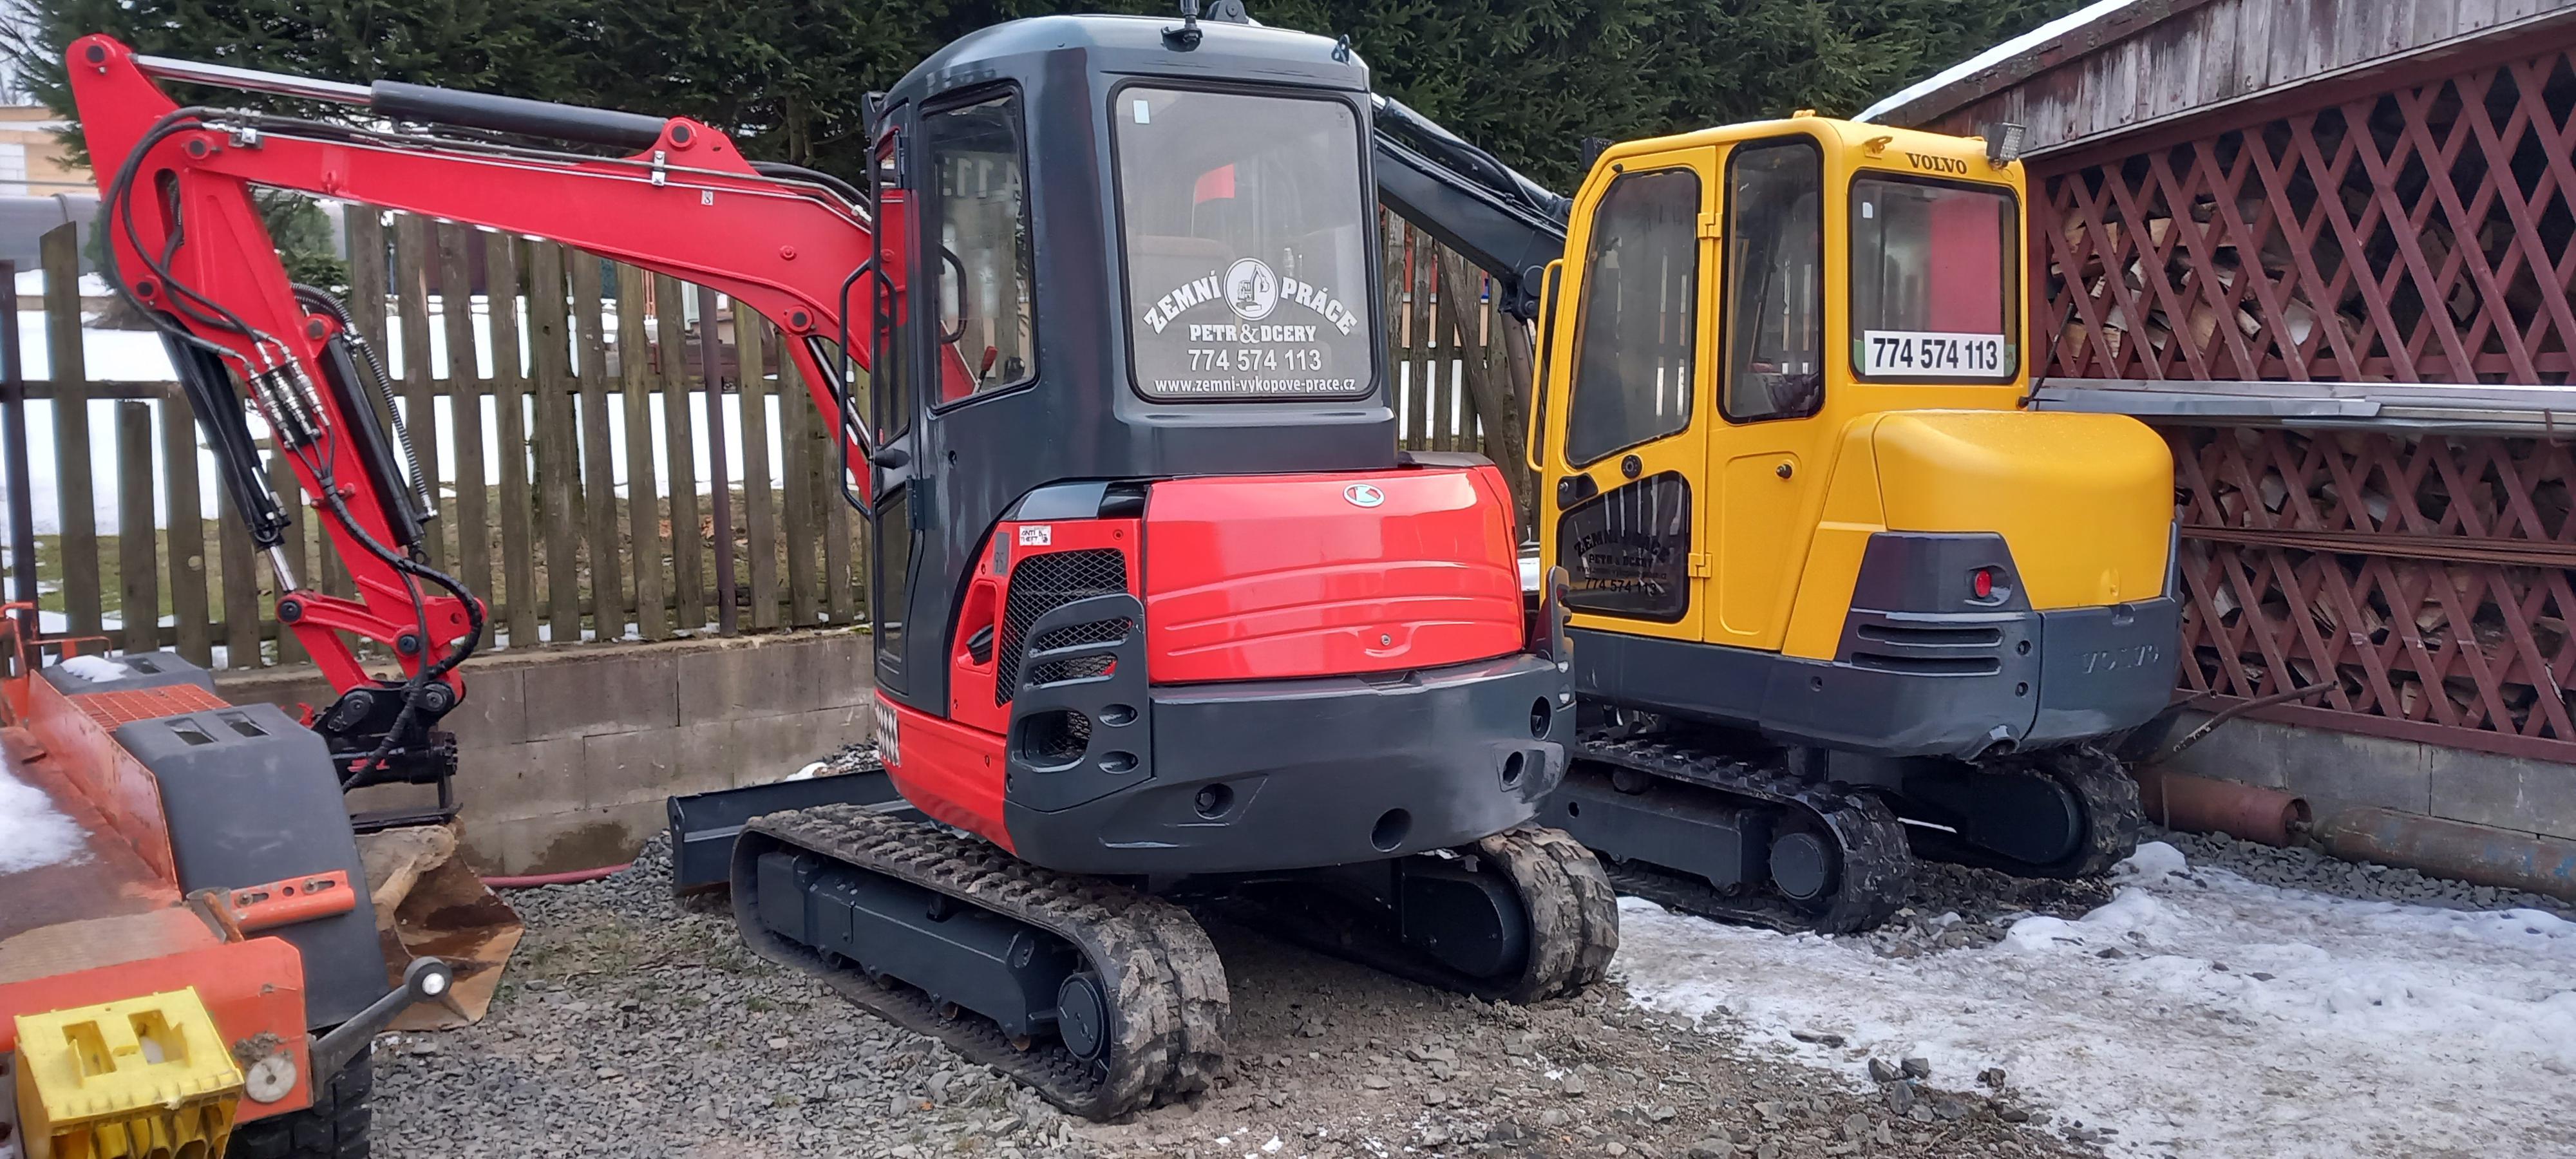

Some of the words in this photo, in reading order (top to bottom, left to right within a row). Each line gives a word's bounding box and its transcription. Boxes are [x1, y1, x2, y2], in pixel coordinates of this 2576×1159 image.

[1905, 152, 1967, 174] VOLVO
[1143, 270, 1222, 334] ZEMNÍ
[1280, 276, 1358, 336] PRÁCE
[1189, 325, 1238, 341] PETR
[1260, 325, 1316, 342] DCERY
[1188, 350, 1230, 371] 774
[1237, 350, 1277, 371] 574
[1284, 350, 1321, 371] 113
[1873, 338, 1913, 368] 774
[1920, 339, 1958, 368] 574
[1965, 341, 1997, 370] 113
[1155, 376, 1356, 393] www.zemni-vykopove-prace.cz
[1585, 577, 1605, 590] 774
[1611, 580, 1631, 593] 574
[1636, 582, 1657, 596] 113
